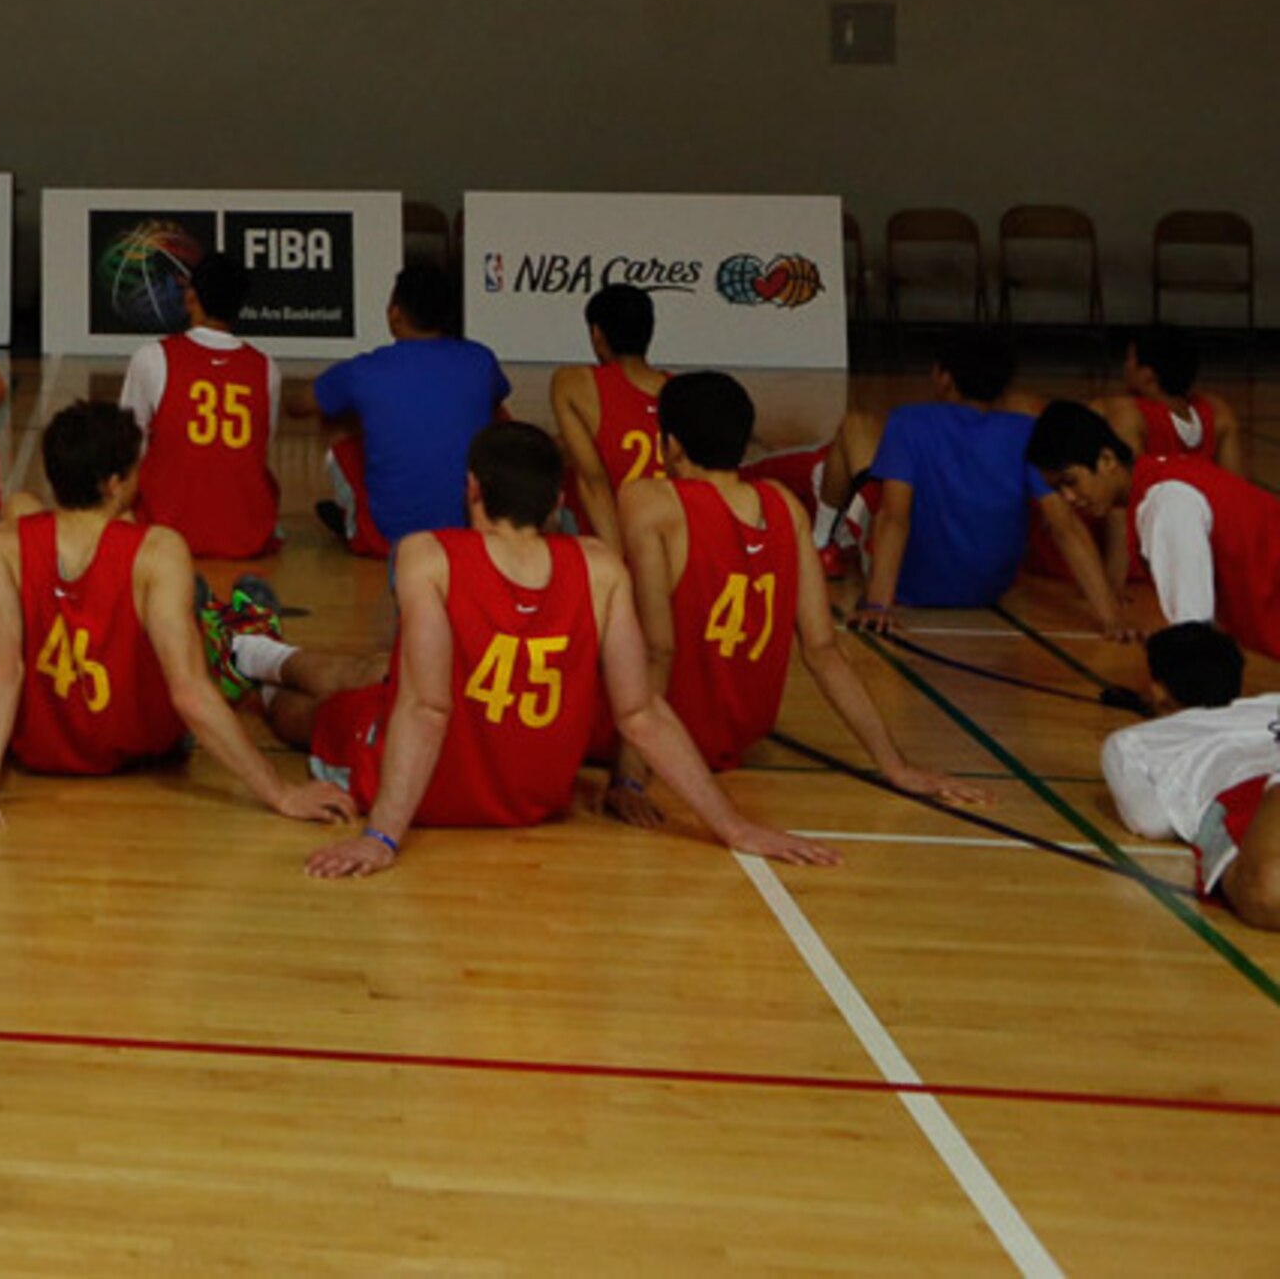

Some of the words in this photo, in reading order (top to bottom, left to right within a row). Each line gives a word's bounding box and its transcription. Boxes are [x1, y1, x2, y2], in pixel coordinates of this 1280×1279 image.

[243, 227, 333, 270] FIBA
[514, 253, 592, 293] NBA
[601, 255, 703, 288] Cares
[187, 378, 253, 450] 35
[621, 429, 668, 483] 2
[465, 632, 571, 730] 45
